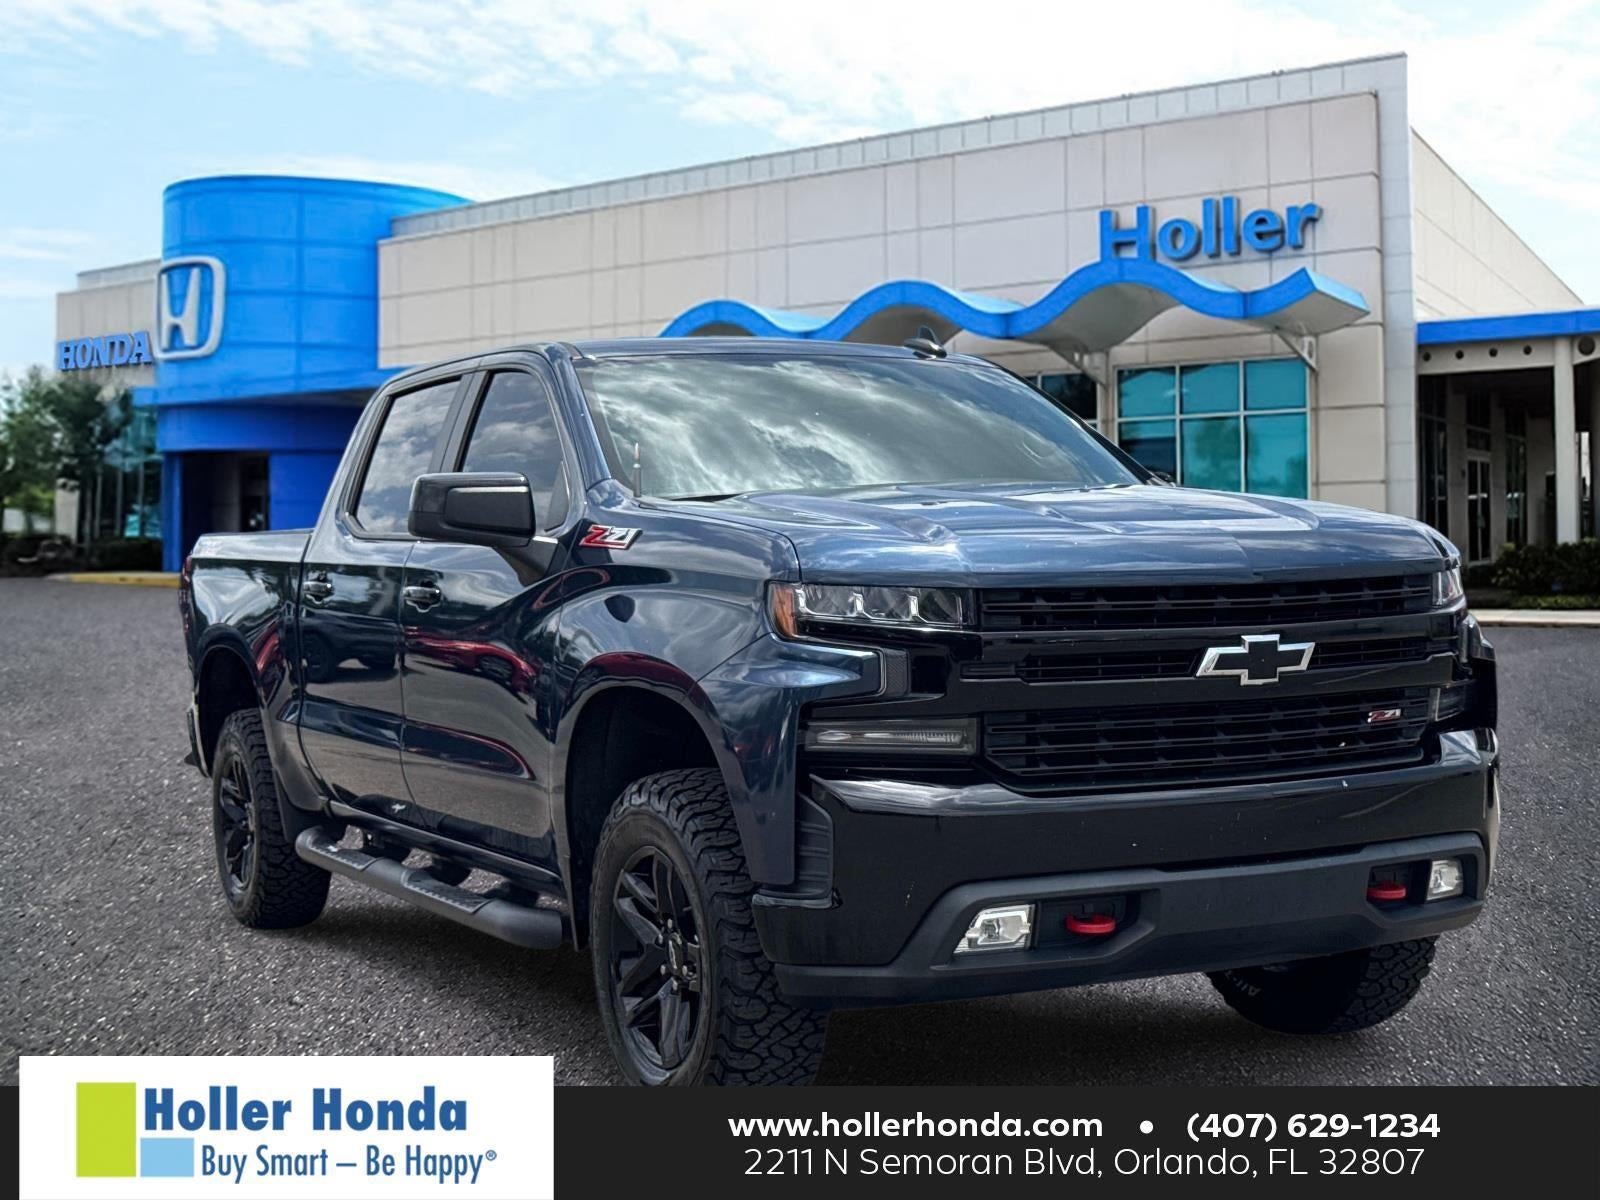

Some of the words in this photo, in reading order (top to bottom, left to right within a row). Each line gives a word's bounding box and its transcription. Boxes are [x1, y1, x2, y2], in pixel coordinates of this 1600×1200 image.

[1098, 195, 1322, 262] Holler
[58, 331, 153, 371] HONDA
[579, 524, 643, 550] Z71
